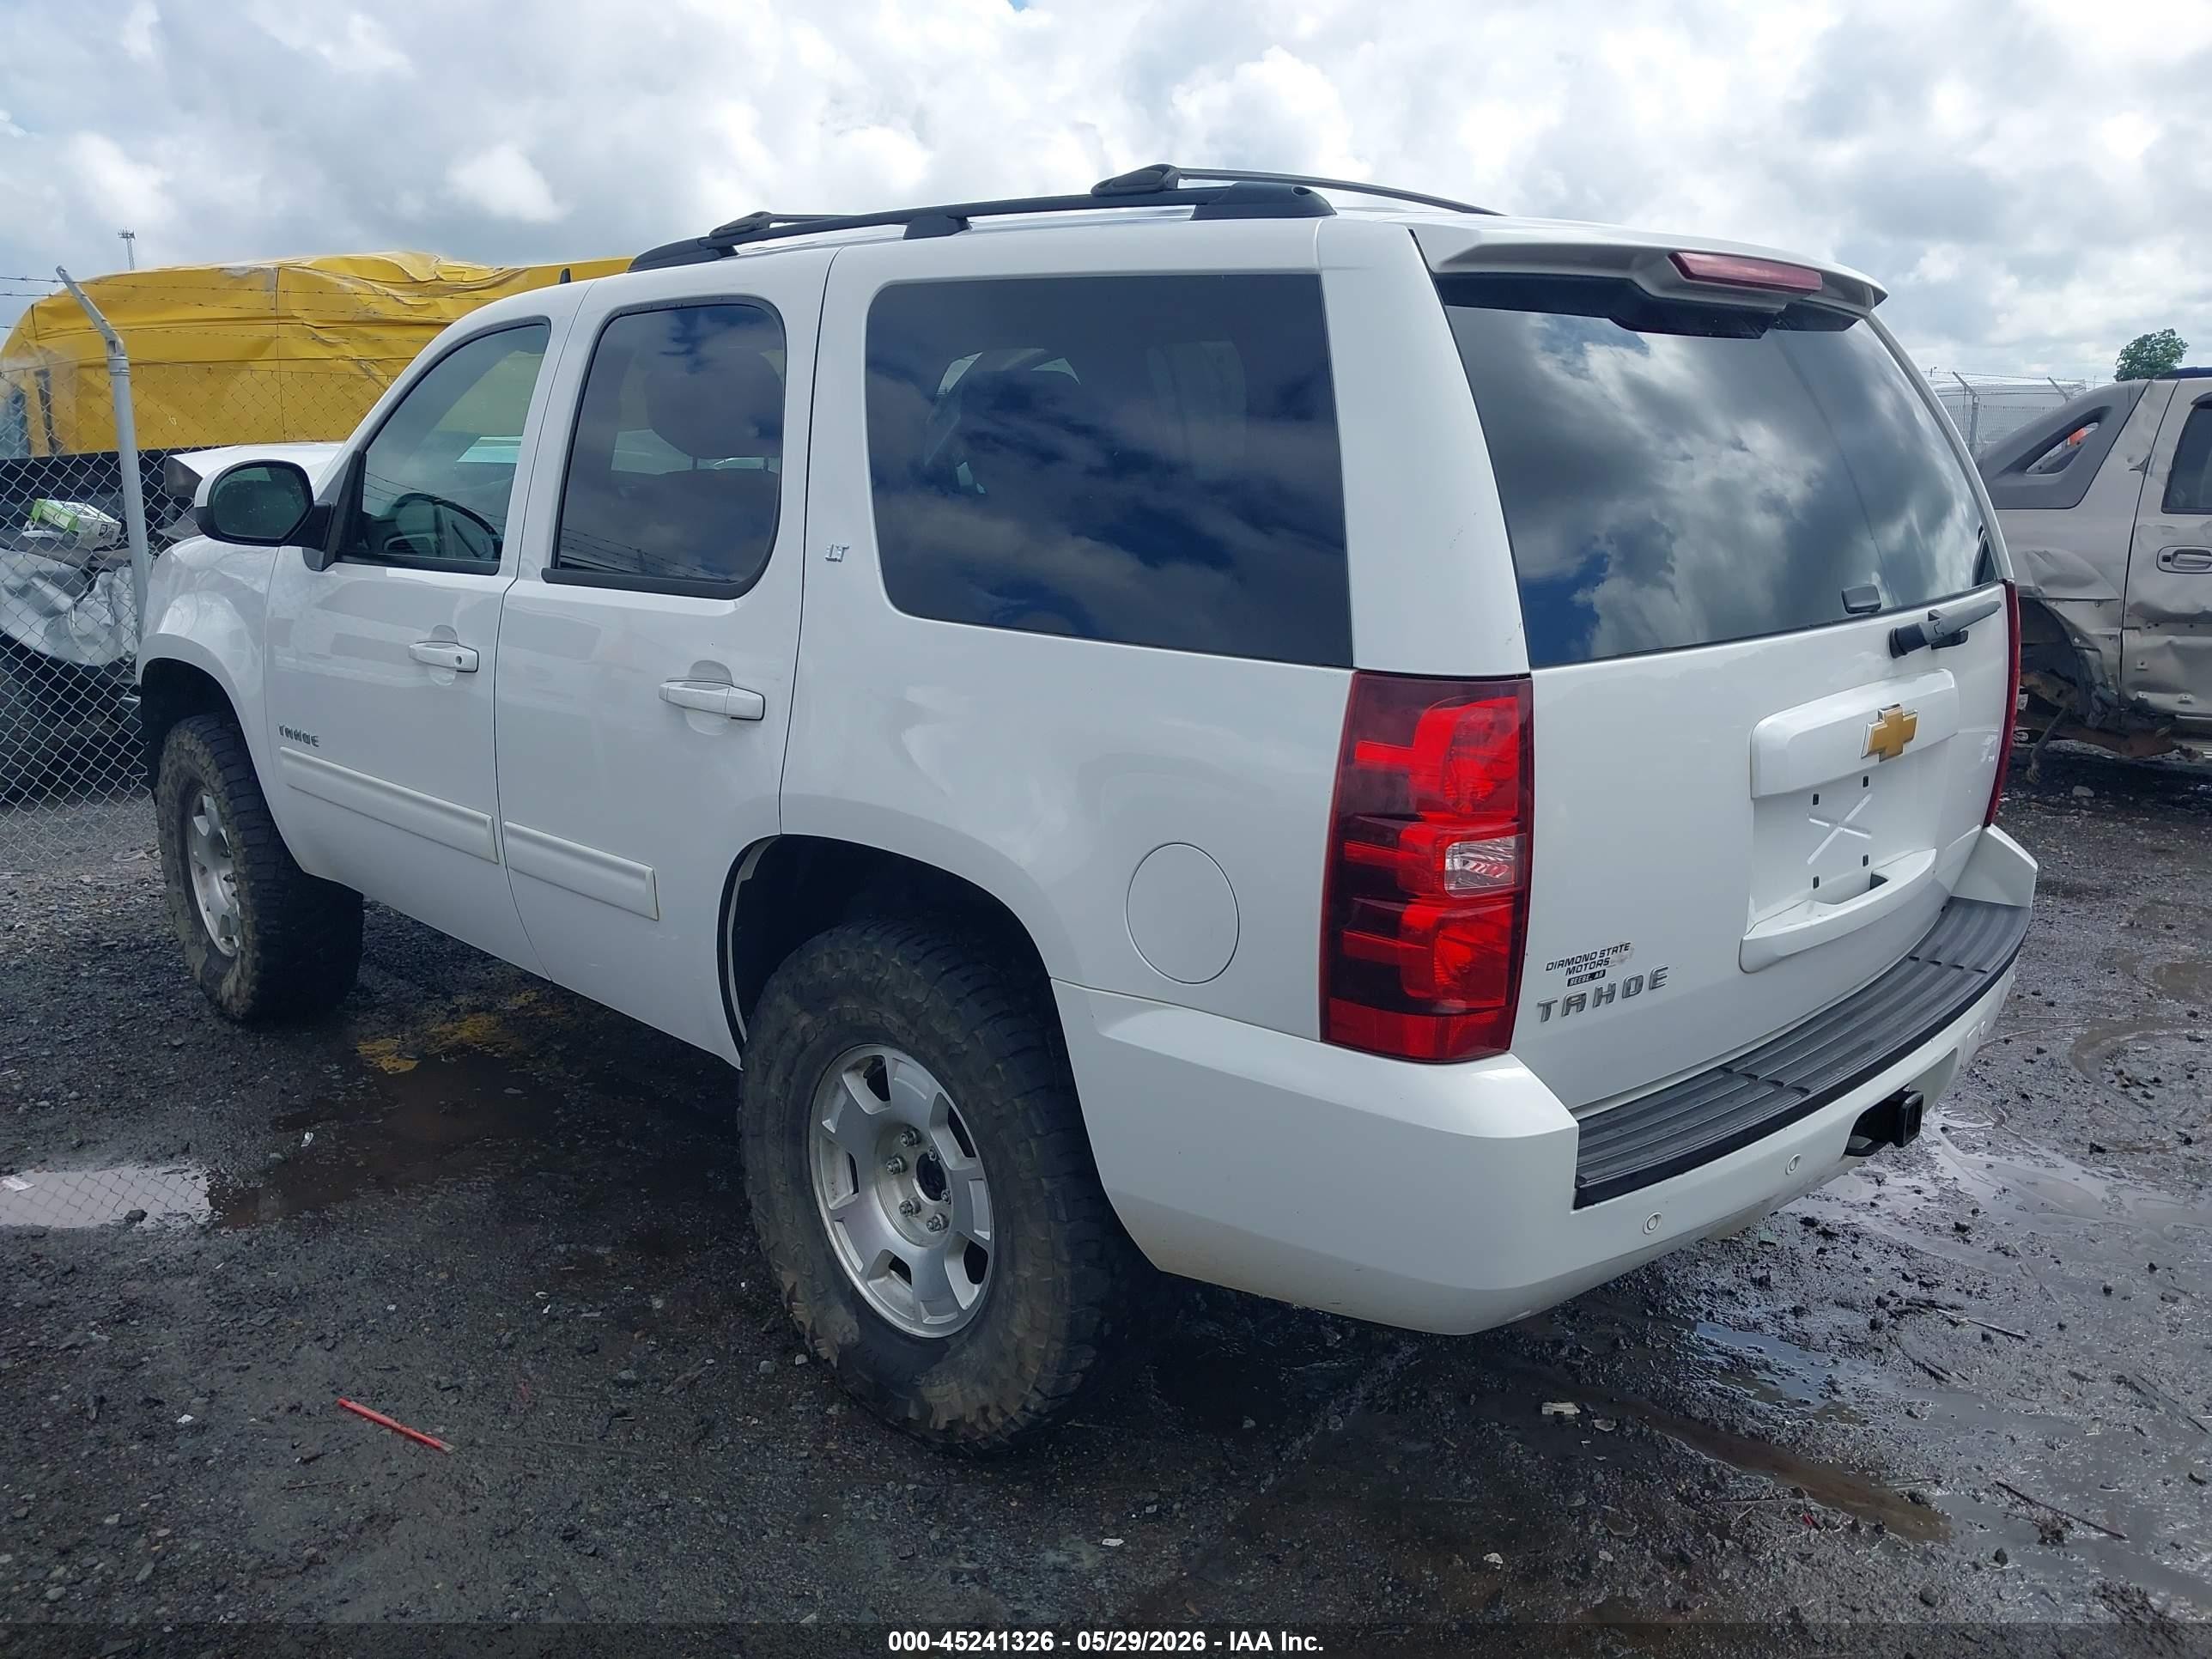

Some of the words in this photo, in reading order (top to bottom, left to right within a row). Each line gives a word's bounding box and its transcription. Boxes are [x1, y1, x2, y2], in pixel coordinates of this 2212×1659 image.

[825, 544, 850, 563] LT
[1545, 951, 1597, 971] DIAMOND
[1599, 942, 1631, 958] STATE
[1565, 957, 1611, 975] MOTORS
[1537, 964, 1669, 1023] TAHOE
